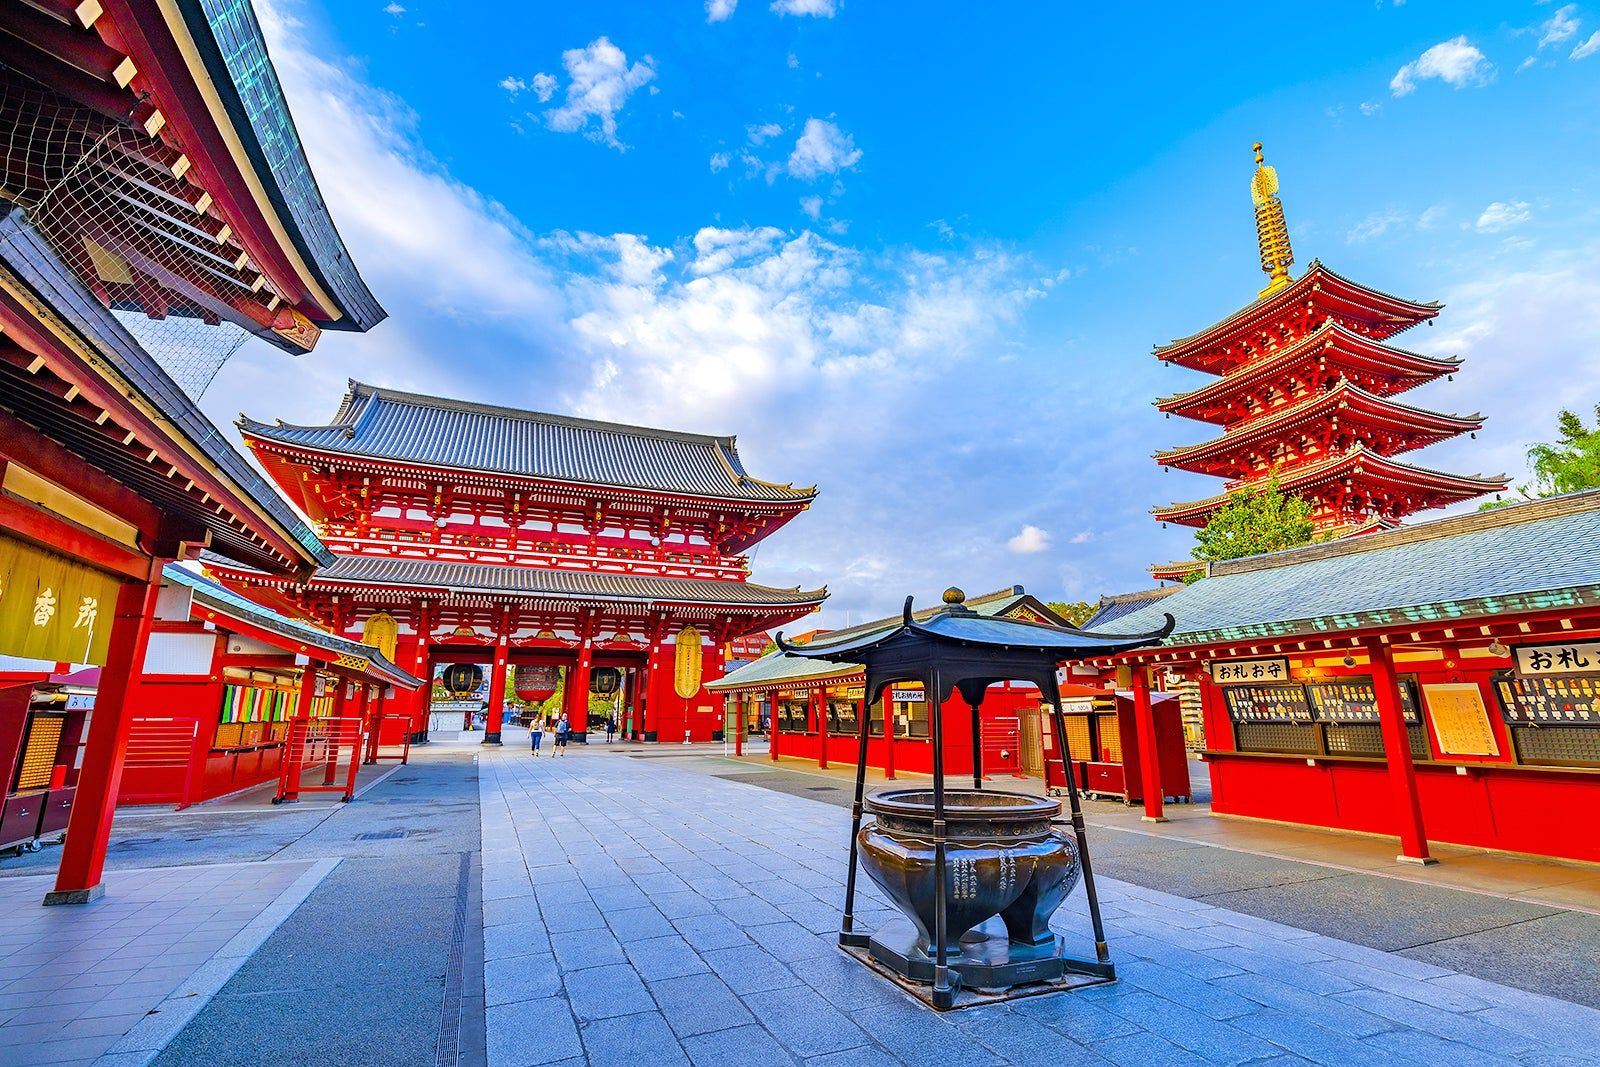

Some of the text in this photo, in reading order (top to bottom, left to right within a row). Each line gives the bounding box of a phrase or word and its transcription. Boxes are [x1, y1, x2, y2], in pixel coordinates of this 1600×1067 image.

[1529, 648, 1600, 670] お札
[1219, 662, 1281, 679] お札お守
